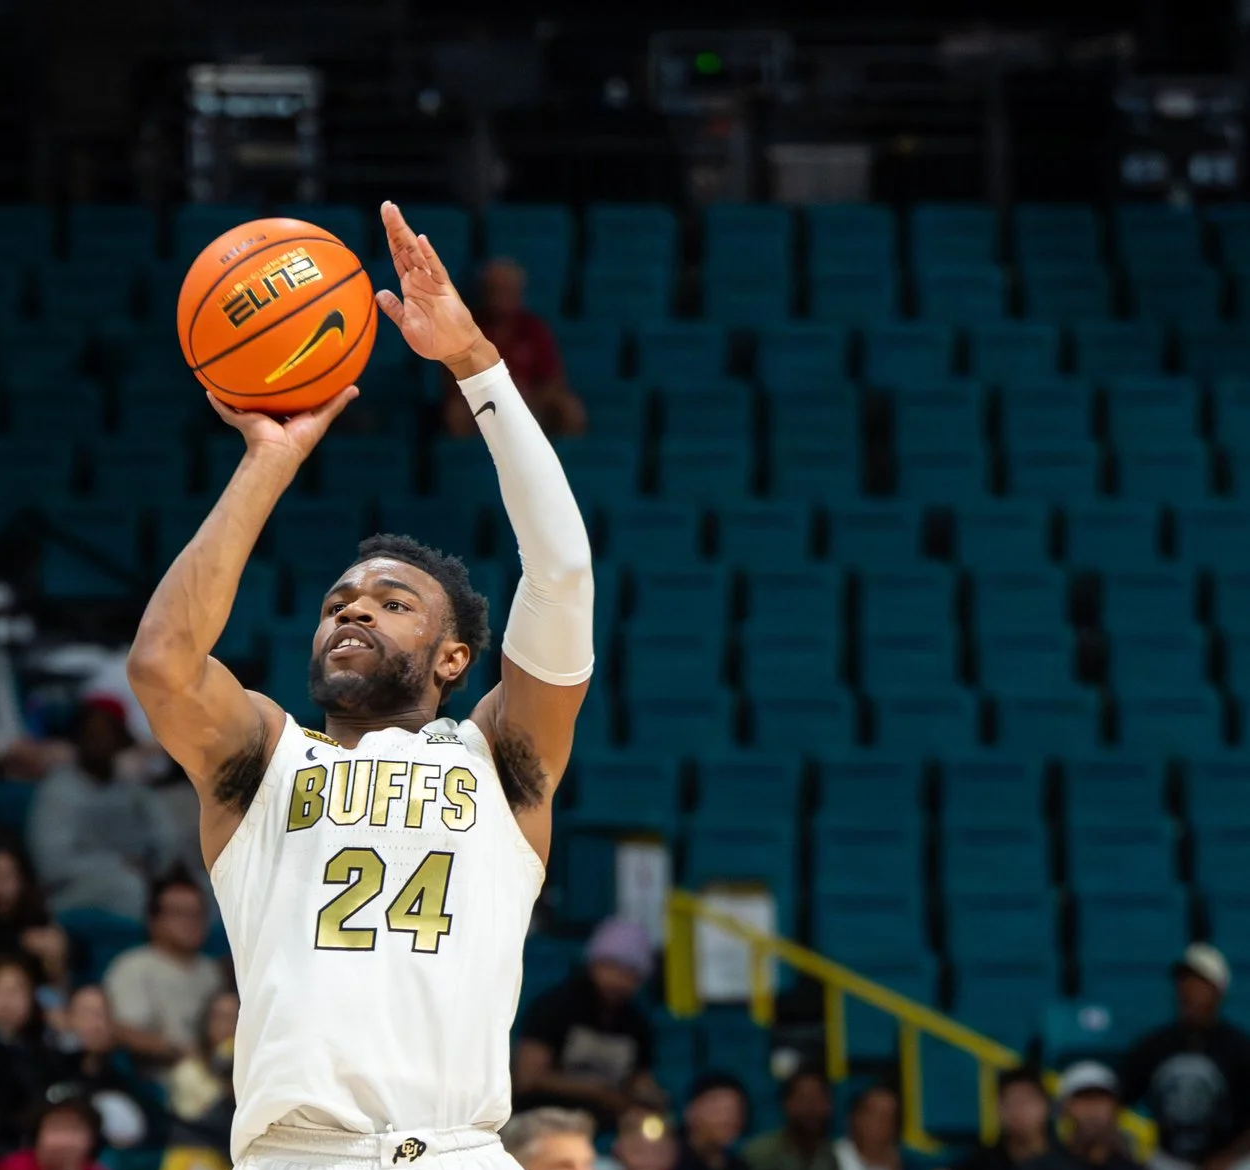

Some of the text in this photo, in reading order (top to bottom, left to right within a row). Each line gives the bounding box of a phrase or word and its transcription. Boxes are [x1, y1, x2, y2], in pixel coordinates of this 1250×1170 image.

[220, 255, 324, 329] ELITE
[286, 759, 478, 833] BUFFS
[314, 846, 455, 954] 24
